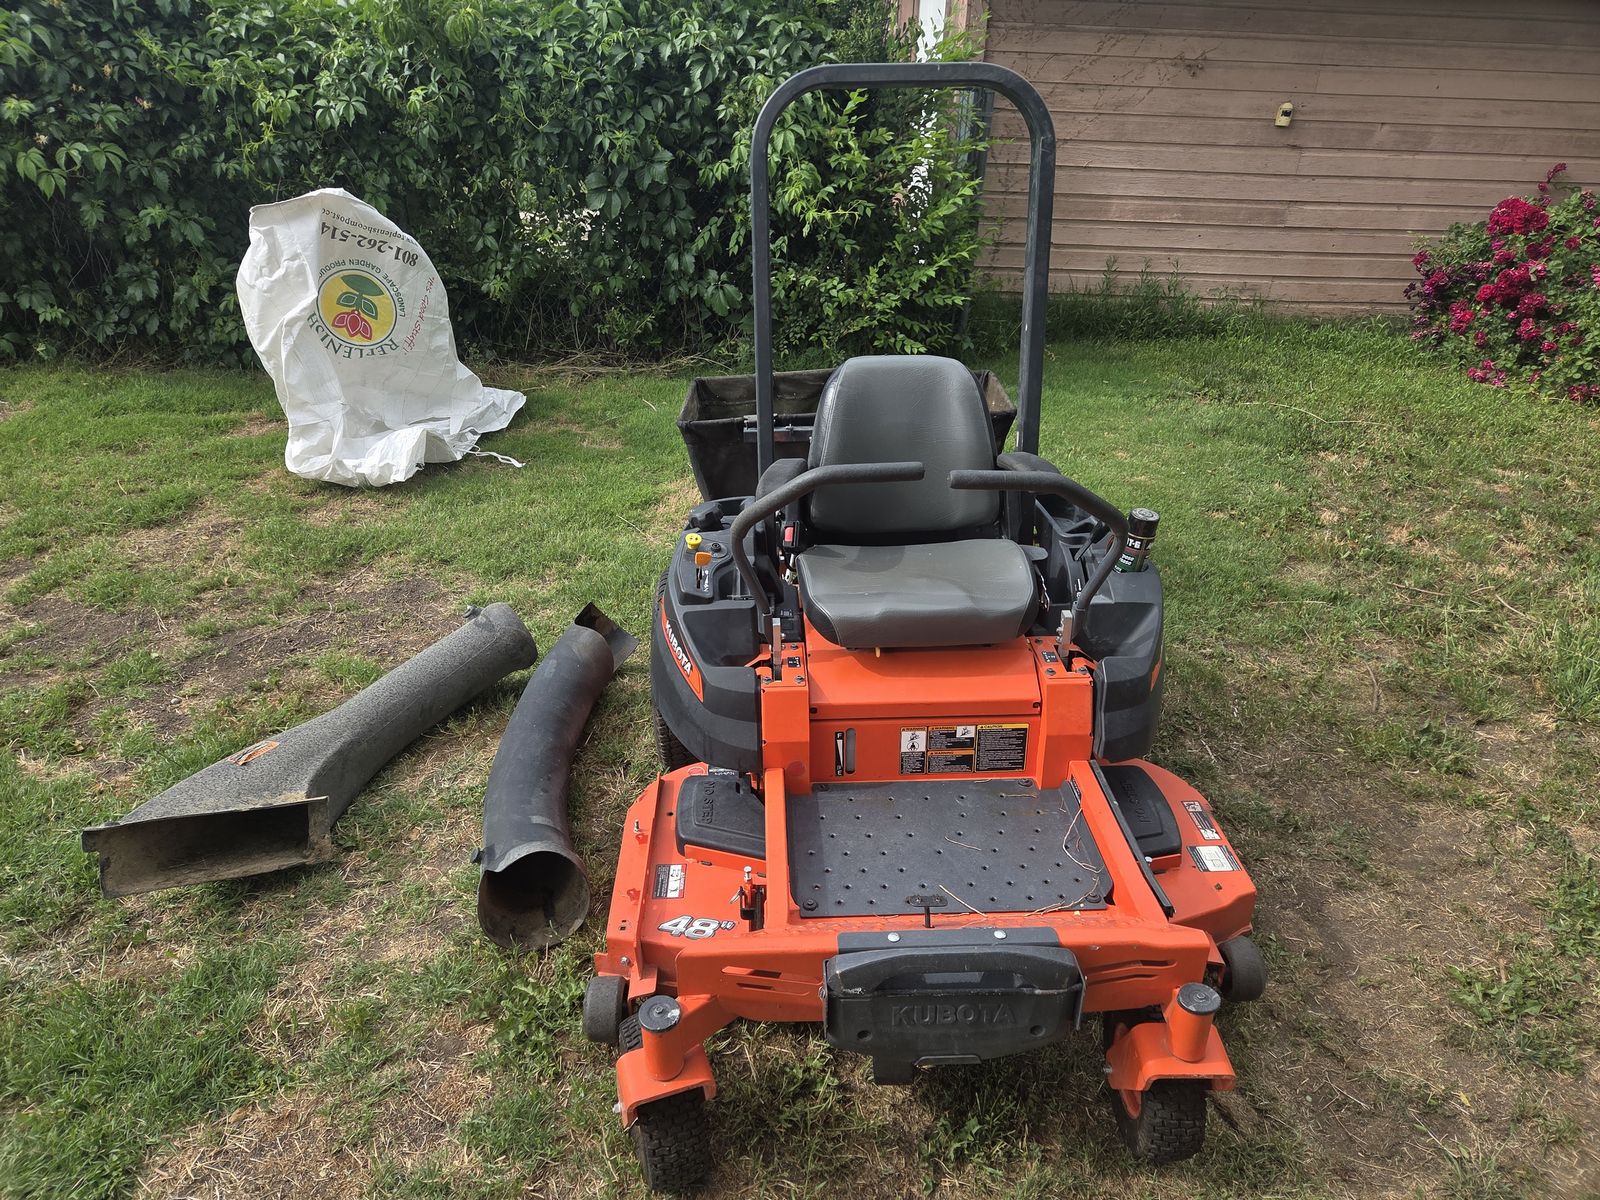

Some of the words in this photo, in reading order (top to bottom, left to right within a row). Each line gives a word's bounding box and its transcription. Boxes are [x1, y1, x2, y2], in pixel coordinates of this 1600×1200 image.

[349, 259, 381, 273] GARDEN
[382, 273, 406, 317] LANDSCAPE
[665, 619, 692, 676] KUBOTA
[702, 797, 714, 825] STEP
[657, 915, 736, 940] 48"
[890, 1003, 1017, 1026] KUBOTA
